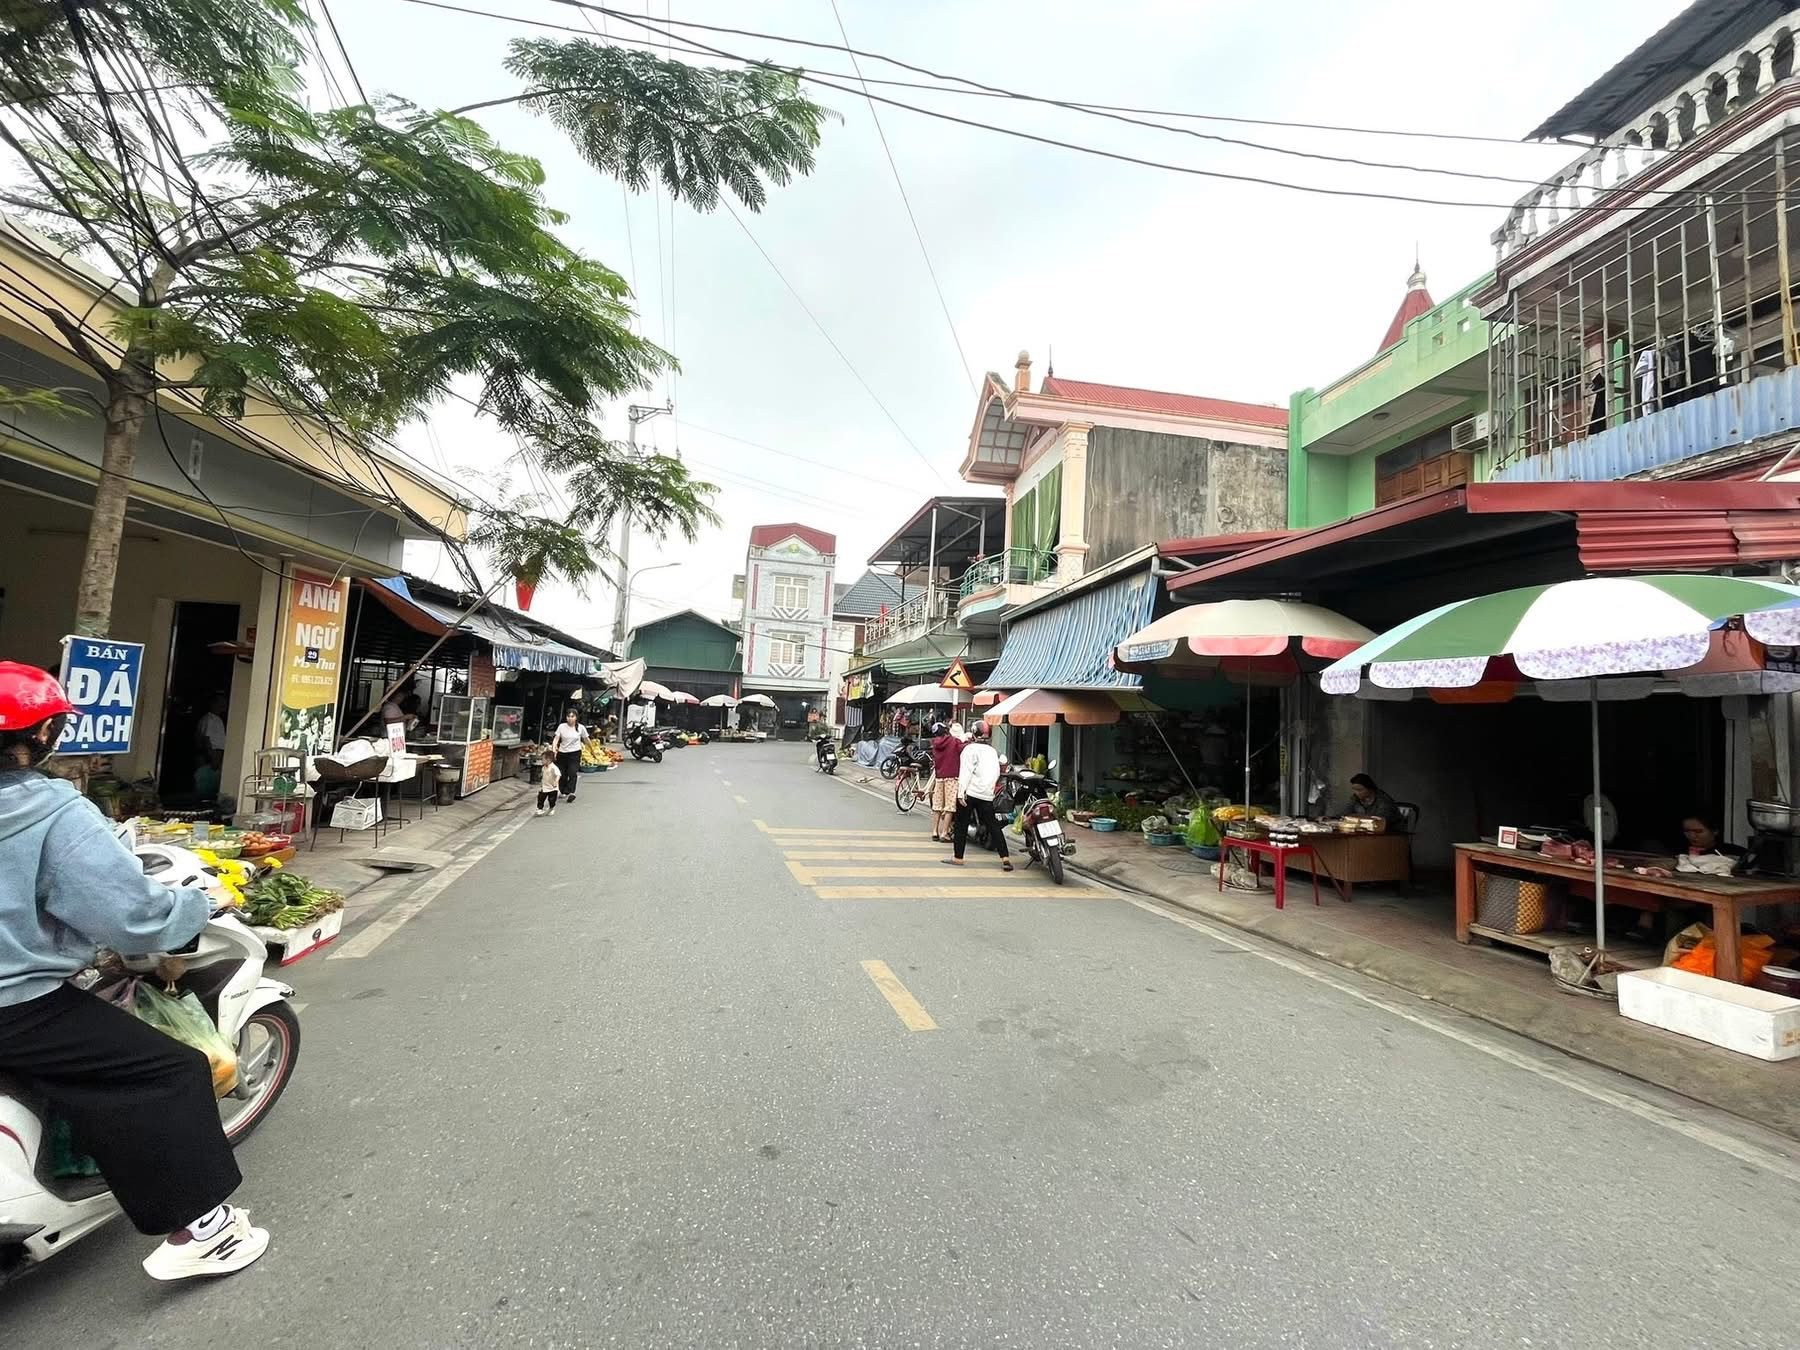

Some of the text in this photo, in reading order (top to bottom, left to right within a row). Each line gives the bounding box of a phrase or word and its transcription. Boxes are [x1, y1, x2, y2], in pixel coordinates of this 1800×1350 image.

[299, 583, 341, 613] ANH
[295, 622, 340, 650] NGỮ
[86, 645, 128, 660] BÁN
[307, 650, 318, 659] 29
[67, 664, 133, 707] ĐÁ
[60, 713, 132, 750] SẠCH
